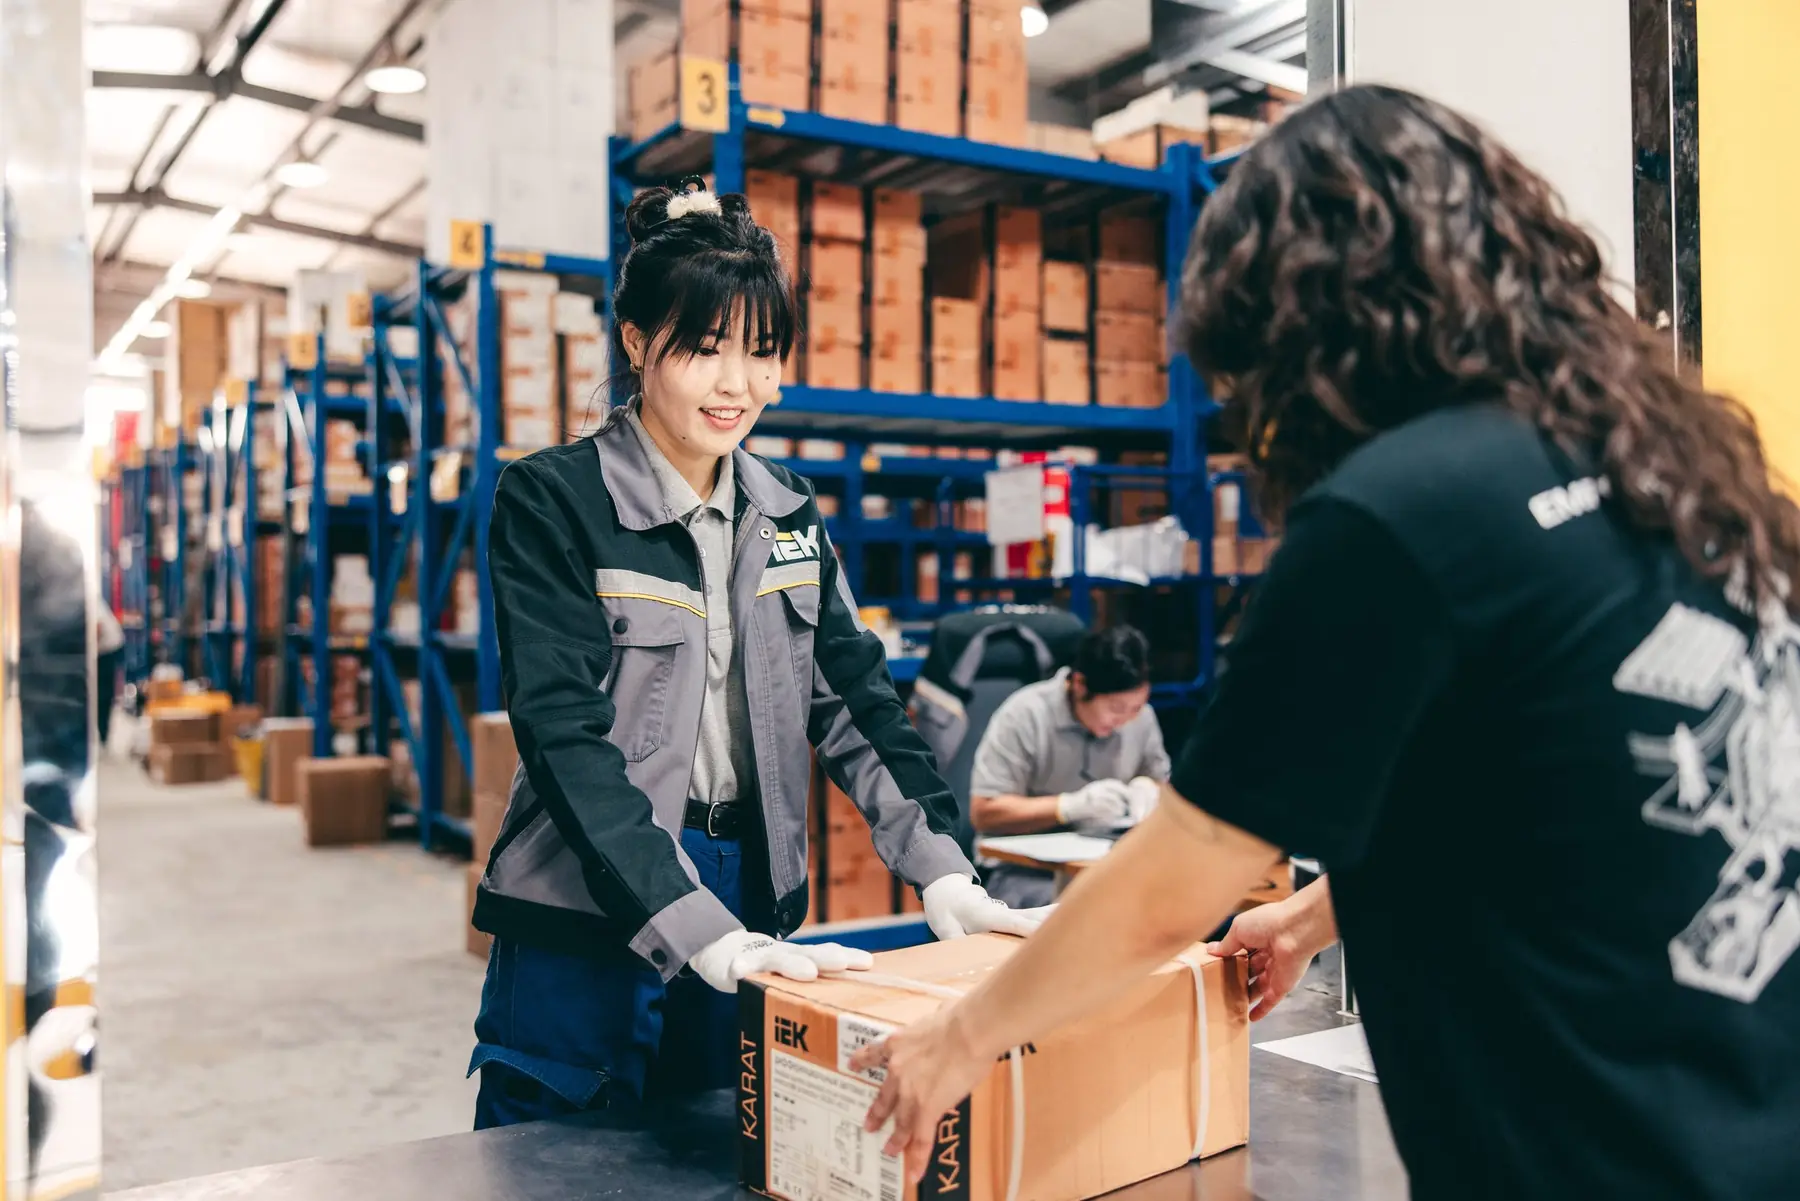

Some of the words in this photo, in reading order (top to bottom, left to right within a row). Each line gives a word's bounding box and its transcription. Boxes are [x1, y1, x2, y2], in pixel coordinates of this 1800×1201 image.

[697, 72, 717, 117] 3
[775, 1016, 808, 1052] IEK
[740, 1031, 758, 1140] KARAT
